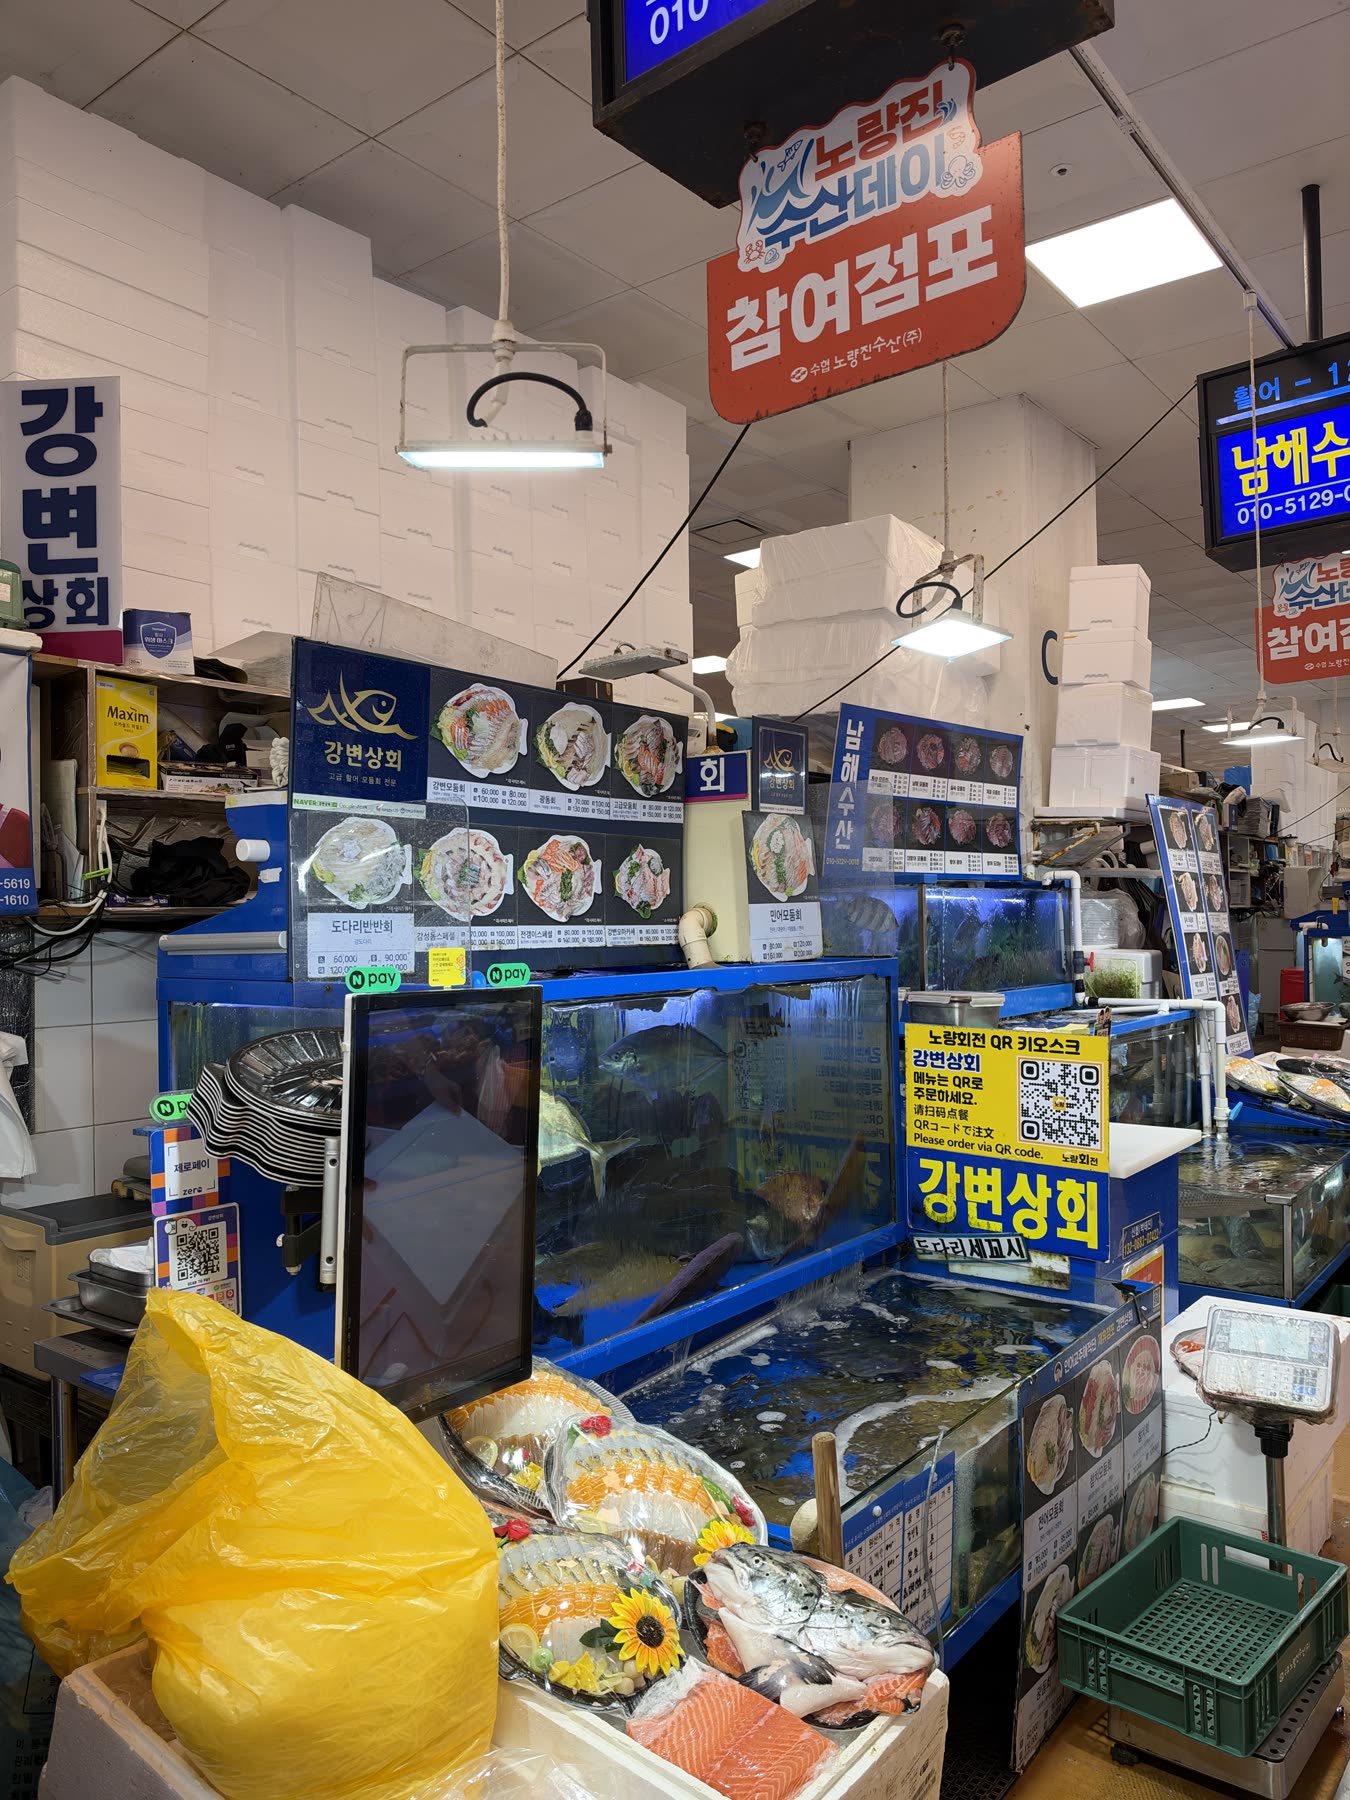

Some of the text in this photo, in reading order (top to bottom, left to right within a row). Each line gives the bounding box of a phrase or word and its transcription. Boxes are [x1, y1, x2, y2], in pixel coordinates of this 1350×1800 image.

[650, 0, 709, 45] 010
[815, 80, 943, 182] 노량진
[756, 133, 945, 249] 수산데이
[725, 204, 998, 372] 참여점포
[810, 327, 923, 376] 수협 노량진수산(주)
[1234, 377, 1281, 411] 활어
[107, 706, 149, 724] Maxim
[324, 741, 402, 772] 강변상회
[328, 773, 343, 782] 고급
[700, 757, 725, 792] 회
[835, 718, 865, 850] 남해수산
[293, 798, 317, 806] NAVER
[481, 787, 527, 799] 60,000 80,000
[331, 919, 393, 934] 도다리반반회
[333, 953, 408, 964] 60,000 90,000
[929, 1029, 1081, 1056] 노량회전 QR 키오스크
[912, 1050, 981, 1073] 강변상회
[913, 1071, 984, 1090] 메뉴는 QR로
[913, 1086, 978, 1106] 주문하세요.
[913, 1104, 970, 1122] 请扫码点餐
[913, 1119, 995, 1140] QRコードで注文
[913, 1132, 1044, 1161] Please order via QR code.
[174, 1158, 210, 1173] 제로페이
[1061, 1152, 1099, 1167] 노량회전
[918, 1158, 1098, 1250] 강변상회
